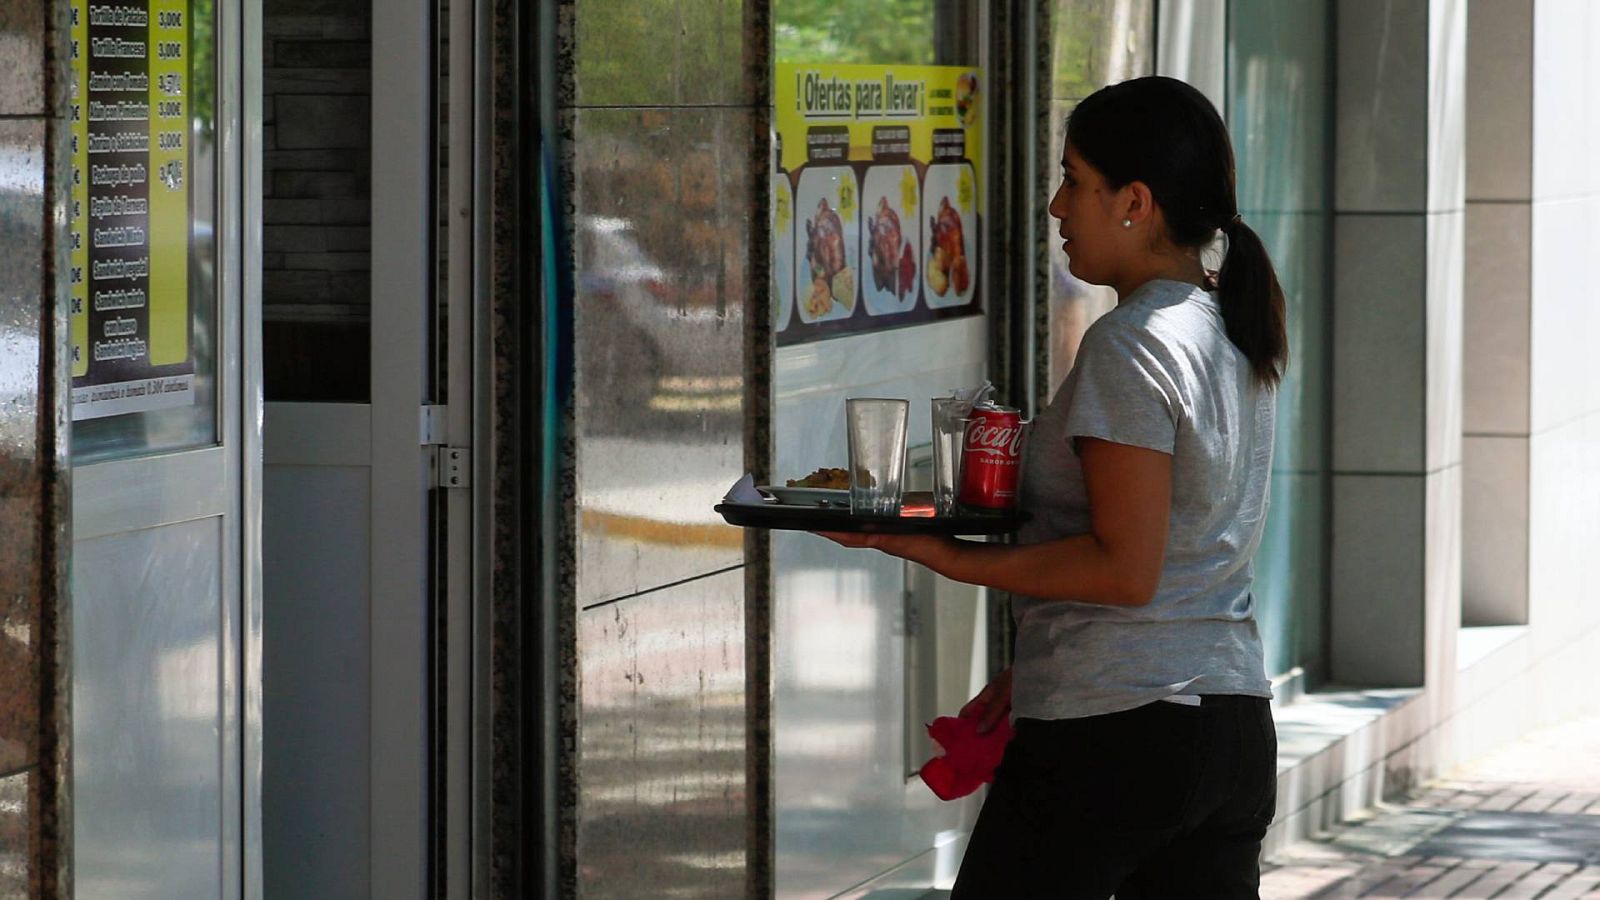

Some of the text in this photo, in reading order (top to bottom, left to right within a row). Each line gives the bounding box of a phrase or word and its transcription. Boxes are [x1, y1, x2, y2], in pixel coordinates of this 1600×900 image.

[90, 5, 112, 25] Tortilla
[113, 6, 123, 25] de
[123, 6, 148, 26] Patatas
[159, 11, 182, 28] 3,00€
[92, 37, 115, 57] Tortilla
[116, 37, 146, 57] Francesa
[158, 43, 181, 60] 3,00€
[805, 73, 851, 111] Ofertas
[855, 82, 882, 119] para
[886, 74, 918, 111] llevar
[158, 101, 181, 118] 3,00€
[159, 131, 182, 149] 3,00€
[92, 164, 120, 187] Pechuga
[120, 164, 129, 182] de
[129, 163, 146, 186] pollo
[113, 196, 122, 215] de
[121, 195, 147, 215] Ternera
[95, 228, 126, 248] Sandwich
[93, 259, 124, 280] Sandwich
[95, 291, 126, 311] Sandwich
[104, 319, 117, 337] con
[95, 341, 126, 361] Sandwich
